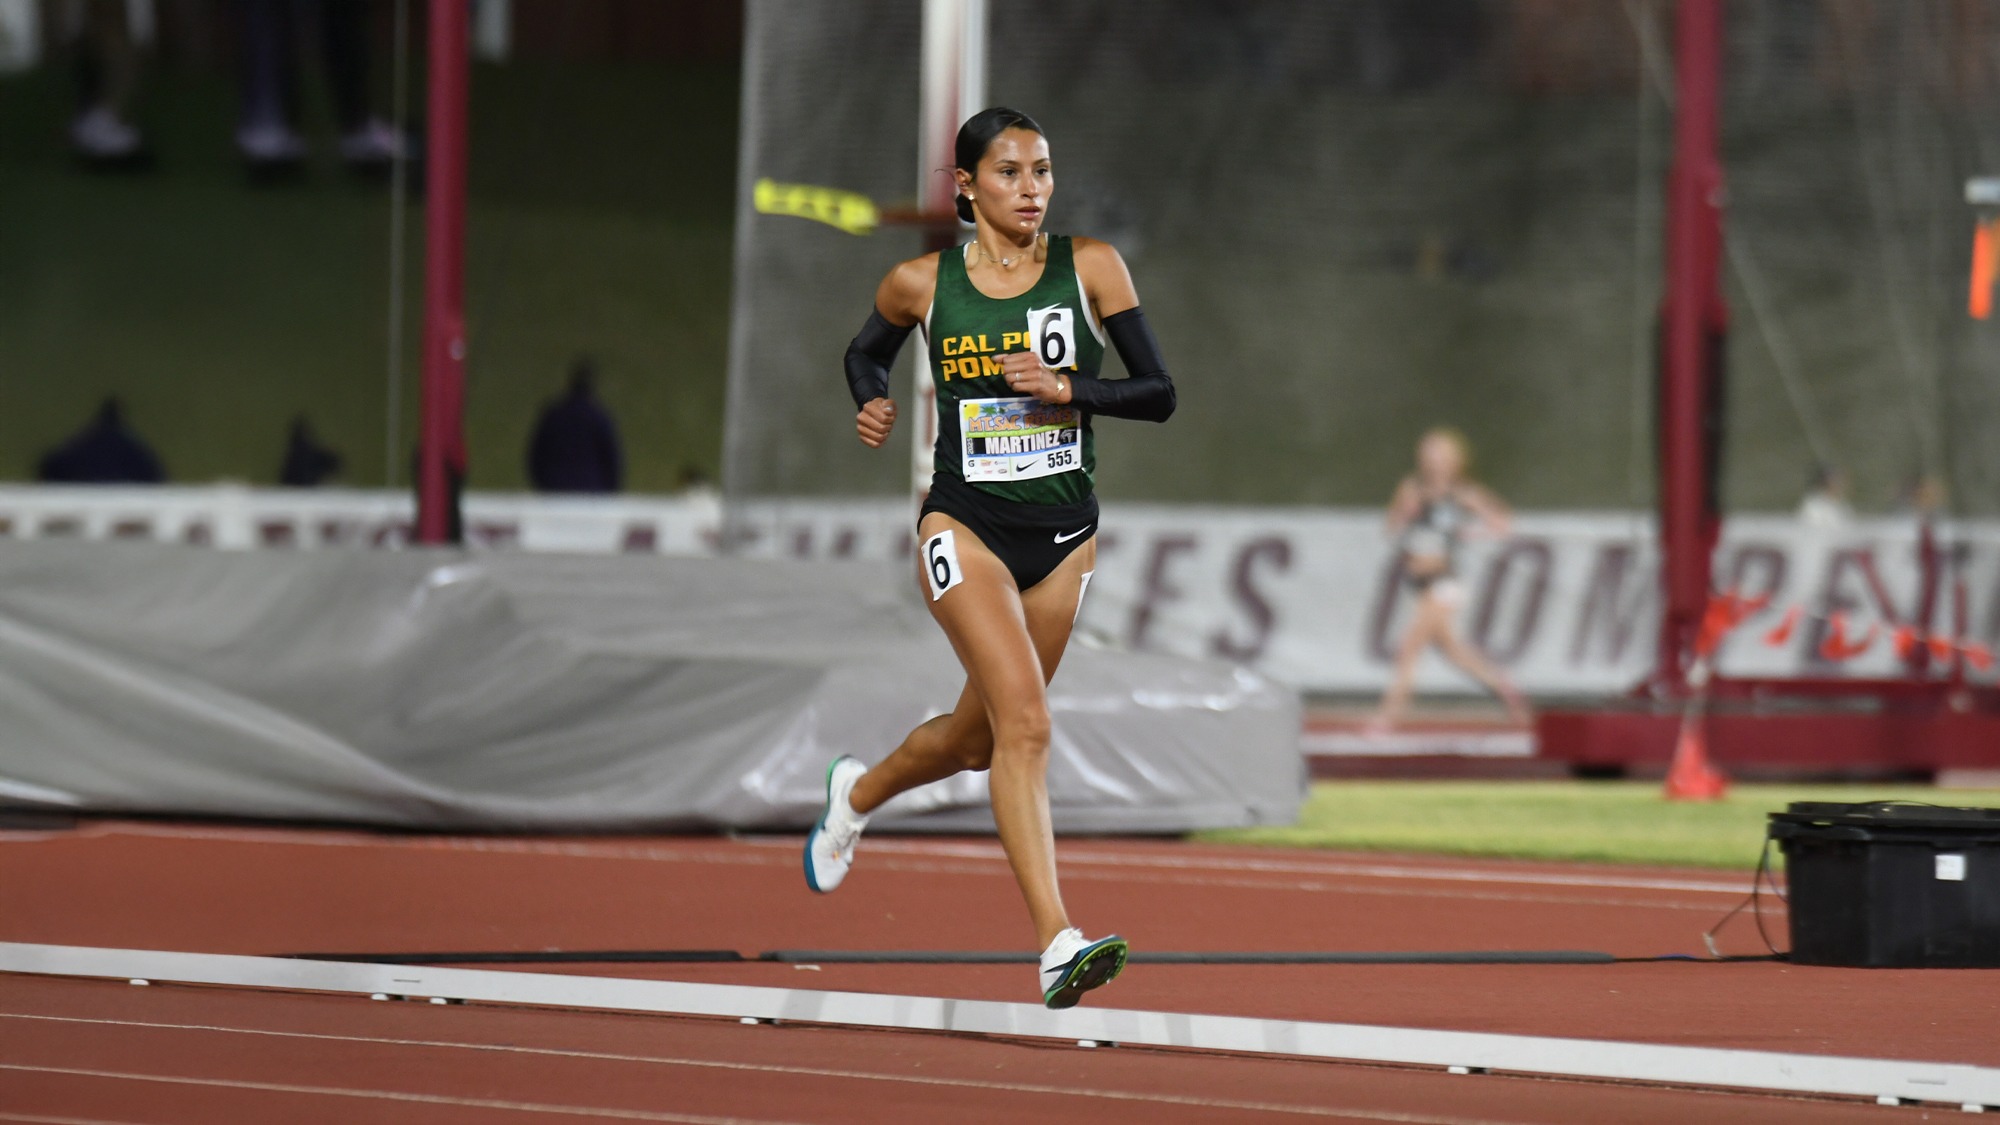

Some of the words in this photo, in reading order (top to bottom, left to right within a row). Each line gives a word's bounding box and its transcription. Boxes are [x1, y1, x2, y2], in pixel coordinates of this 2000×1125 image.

[943, 335, 996, 356] CAL
[1040, 312, 1066, 366] 6
[985, 430, 1060, 455] MARTINEZ
[1047, 449, 1072, 469] 555
[929, 537, 951, 590] 6
